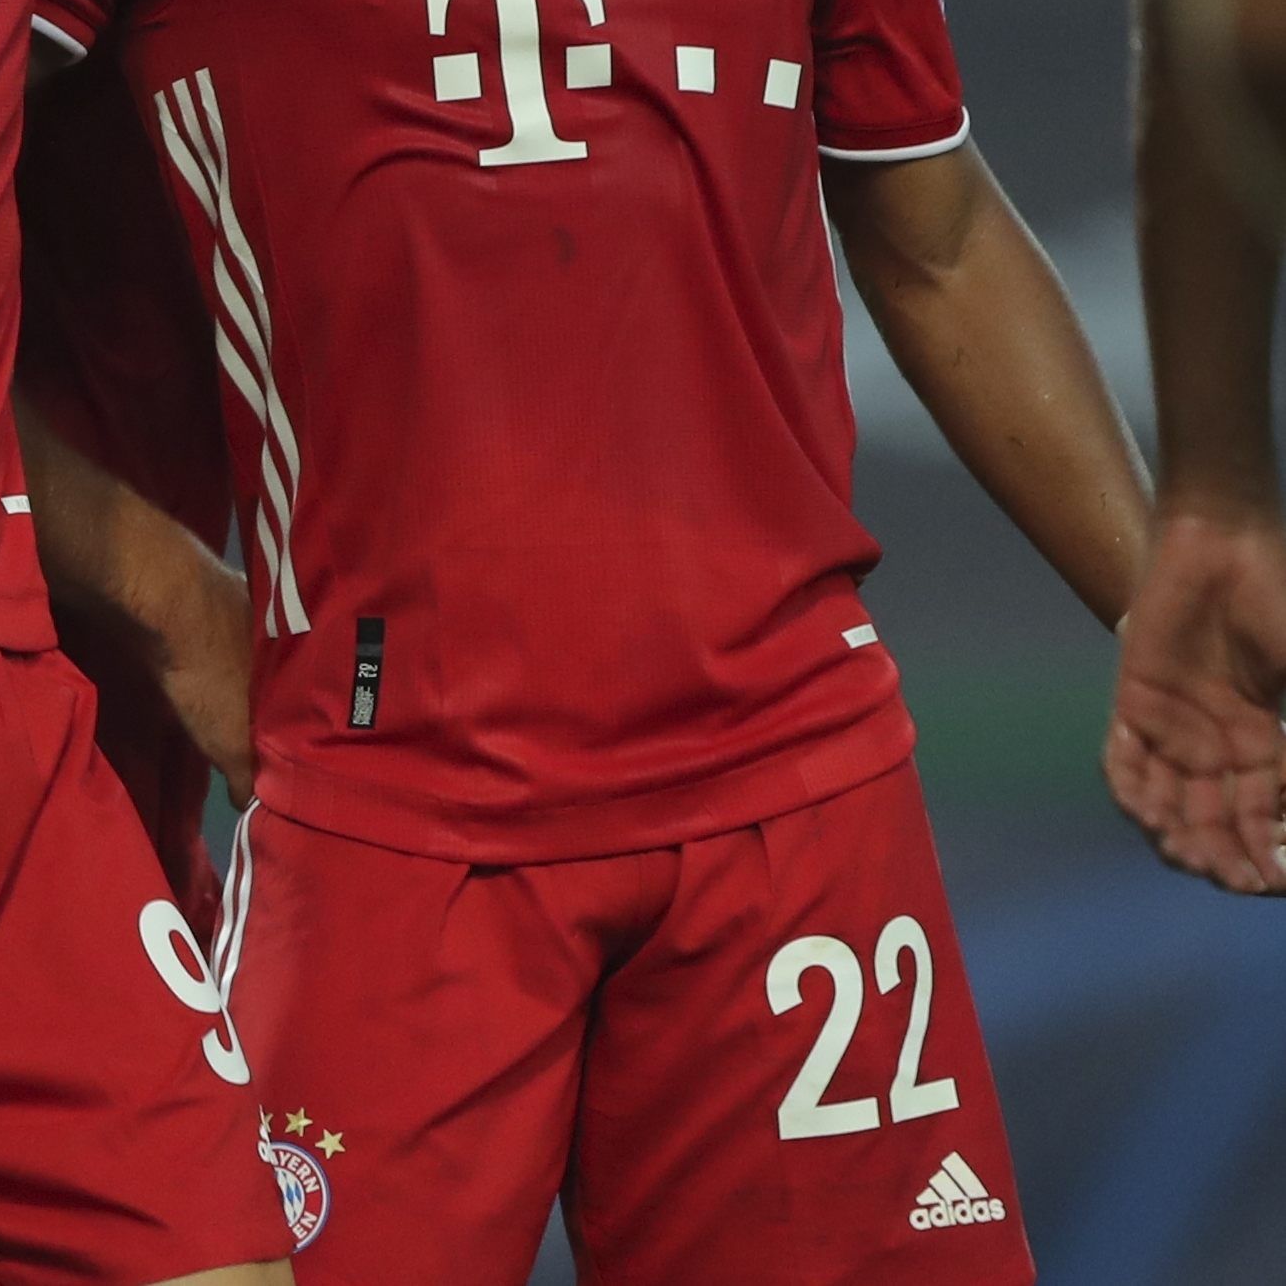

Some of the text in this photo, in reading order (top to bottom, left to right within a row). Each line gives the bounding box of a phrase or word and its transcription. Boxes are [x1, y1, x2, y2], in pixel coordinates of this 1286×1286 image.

[139, 899, 251, 1085] 9
[766, 915, 960, 1140] 22
[269, 1150, 320, 1193] YERN
[909, 1198, 1006, 1230] adidas
